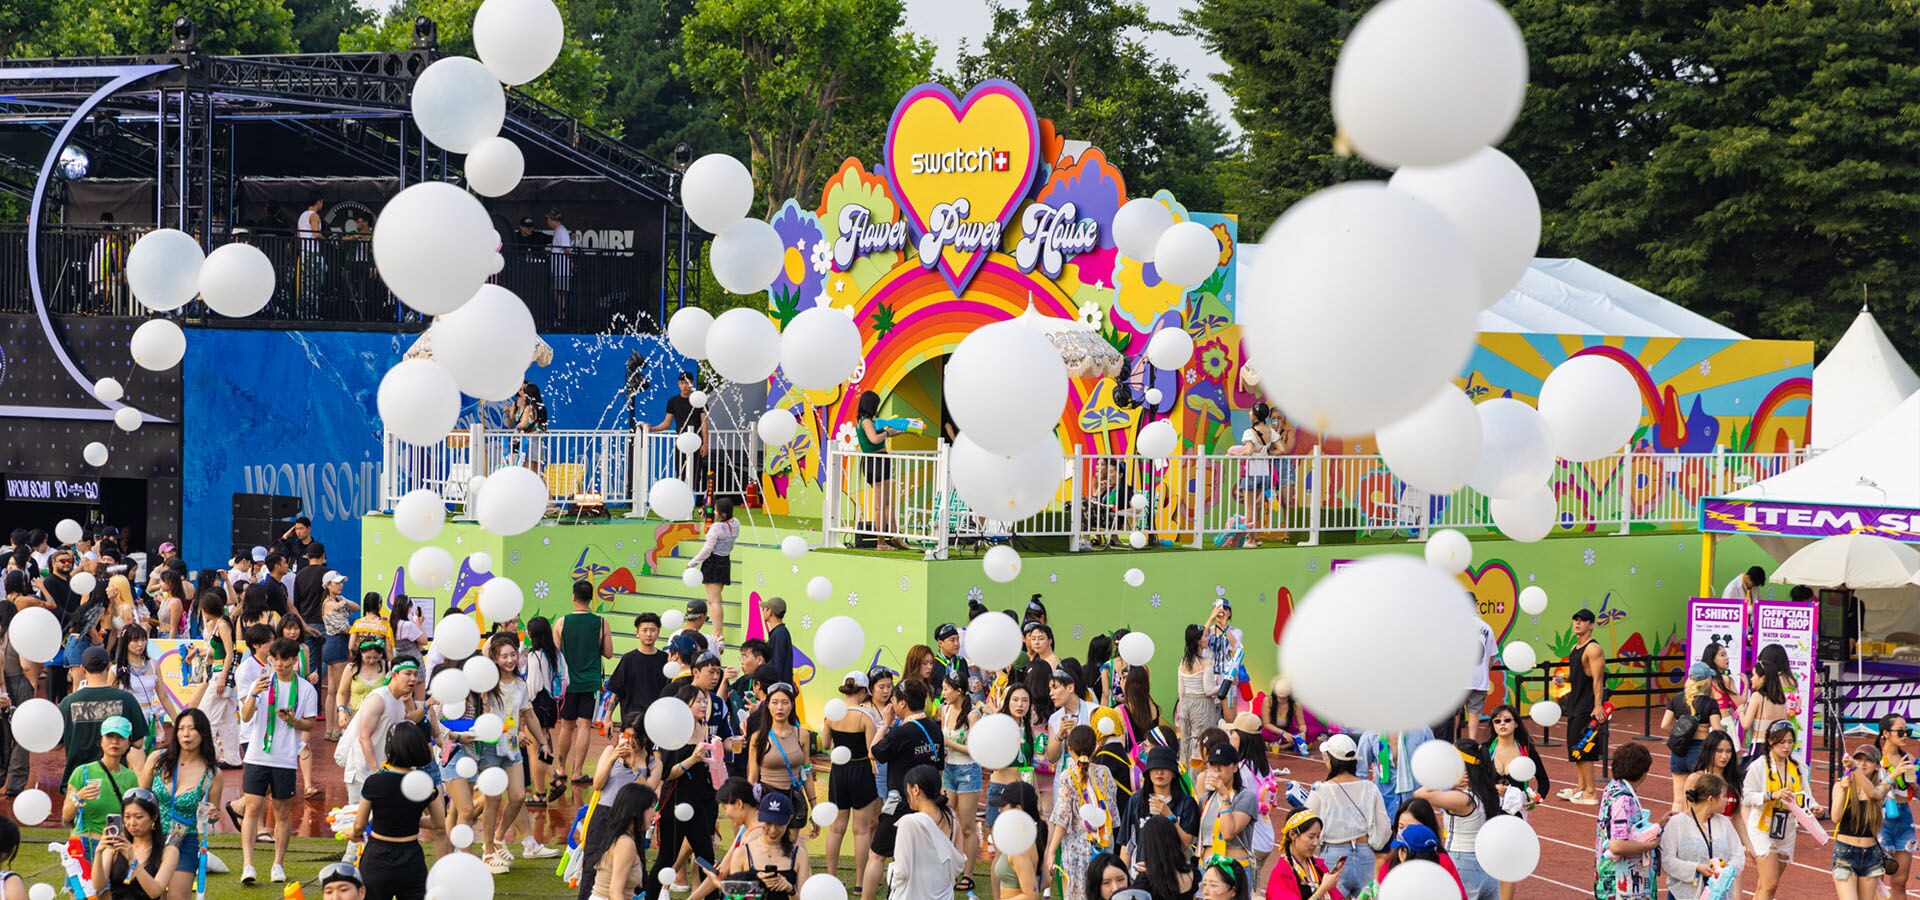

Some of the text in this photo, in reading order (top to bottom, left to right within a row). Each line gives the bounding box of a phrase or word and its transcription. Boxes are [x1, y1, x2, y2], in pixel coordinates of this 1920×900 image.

[911, 147, 993, 174] swatch
[834, 198, 1099, 279] Flower Power House
[1744, 506, 1863, 530] ITEM
[1696, 607, 1740, 621] T-SHIRTS
[1763, 609, 1809, 618] OFFICIAL
[1763, 617, 1809, 629] ITEM SHOP
